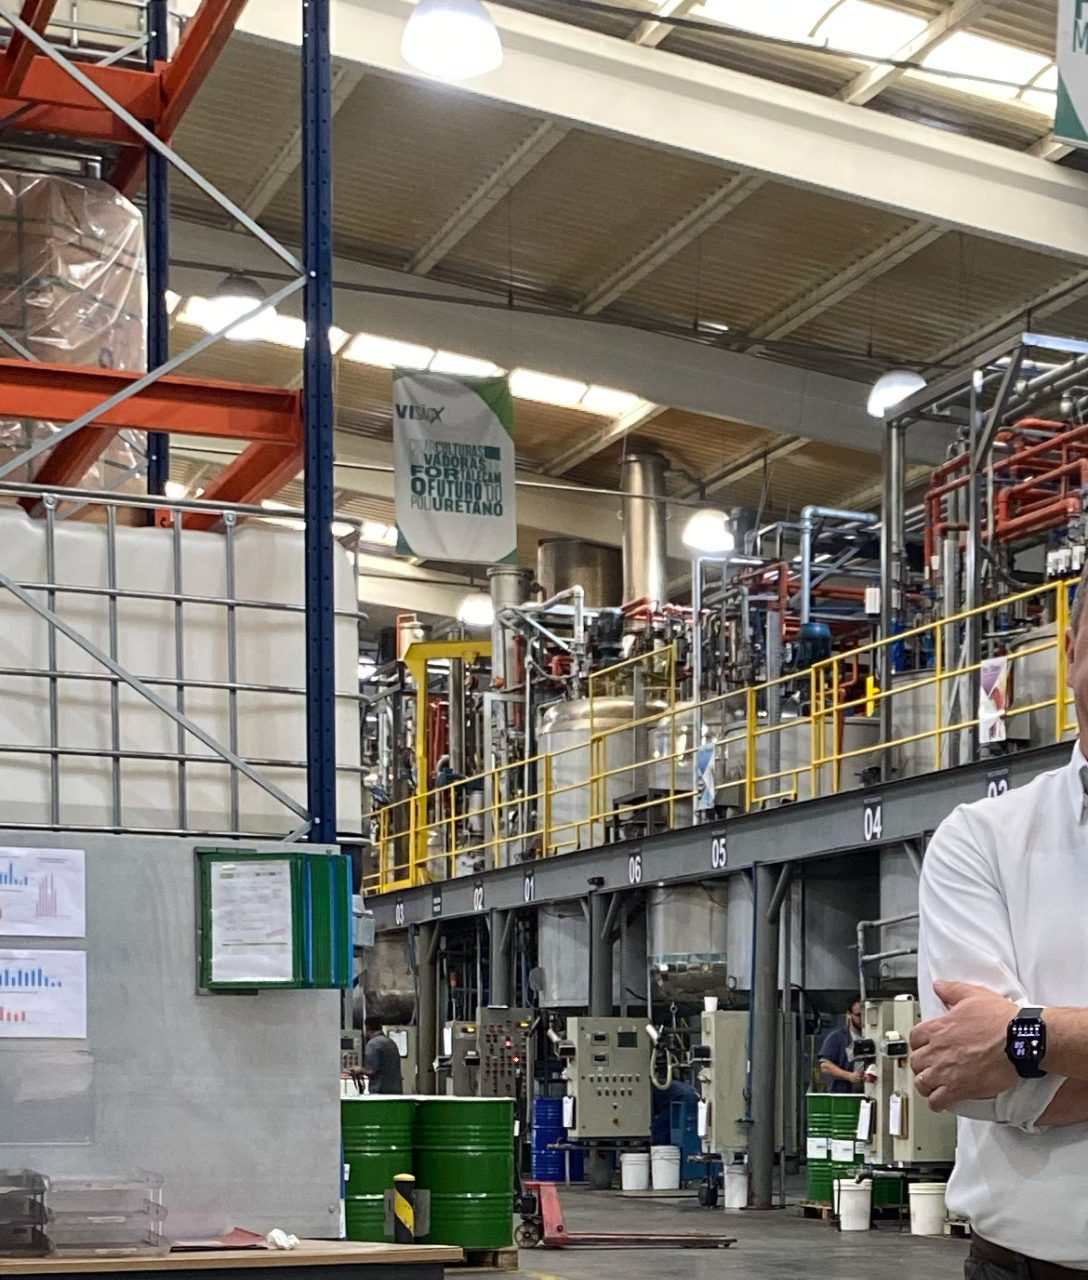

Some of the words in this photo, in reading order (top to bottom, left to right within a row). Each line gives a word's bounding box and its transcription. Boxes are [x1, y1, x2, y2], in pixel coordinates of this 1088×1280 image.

[864, 805, 883, 841] 04
[711, 837, 727, 868] 05
[628, 855, 642, 884] 06
[473, 887, 484, 911] 02
[524, 875, 535, 903] 01
